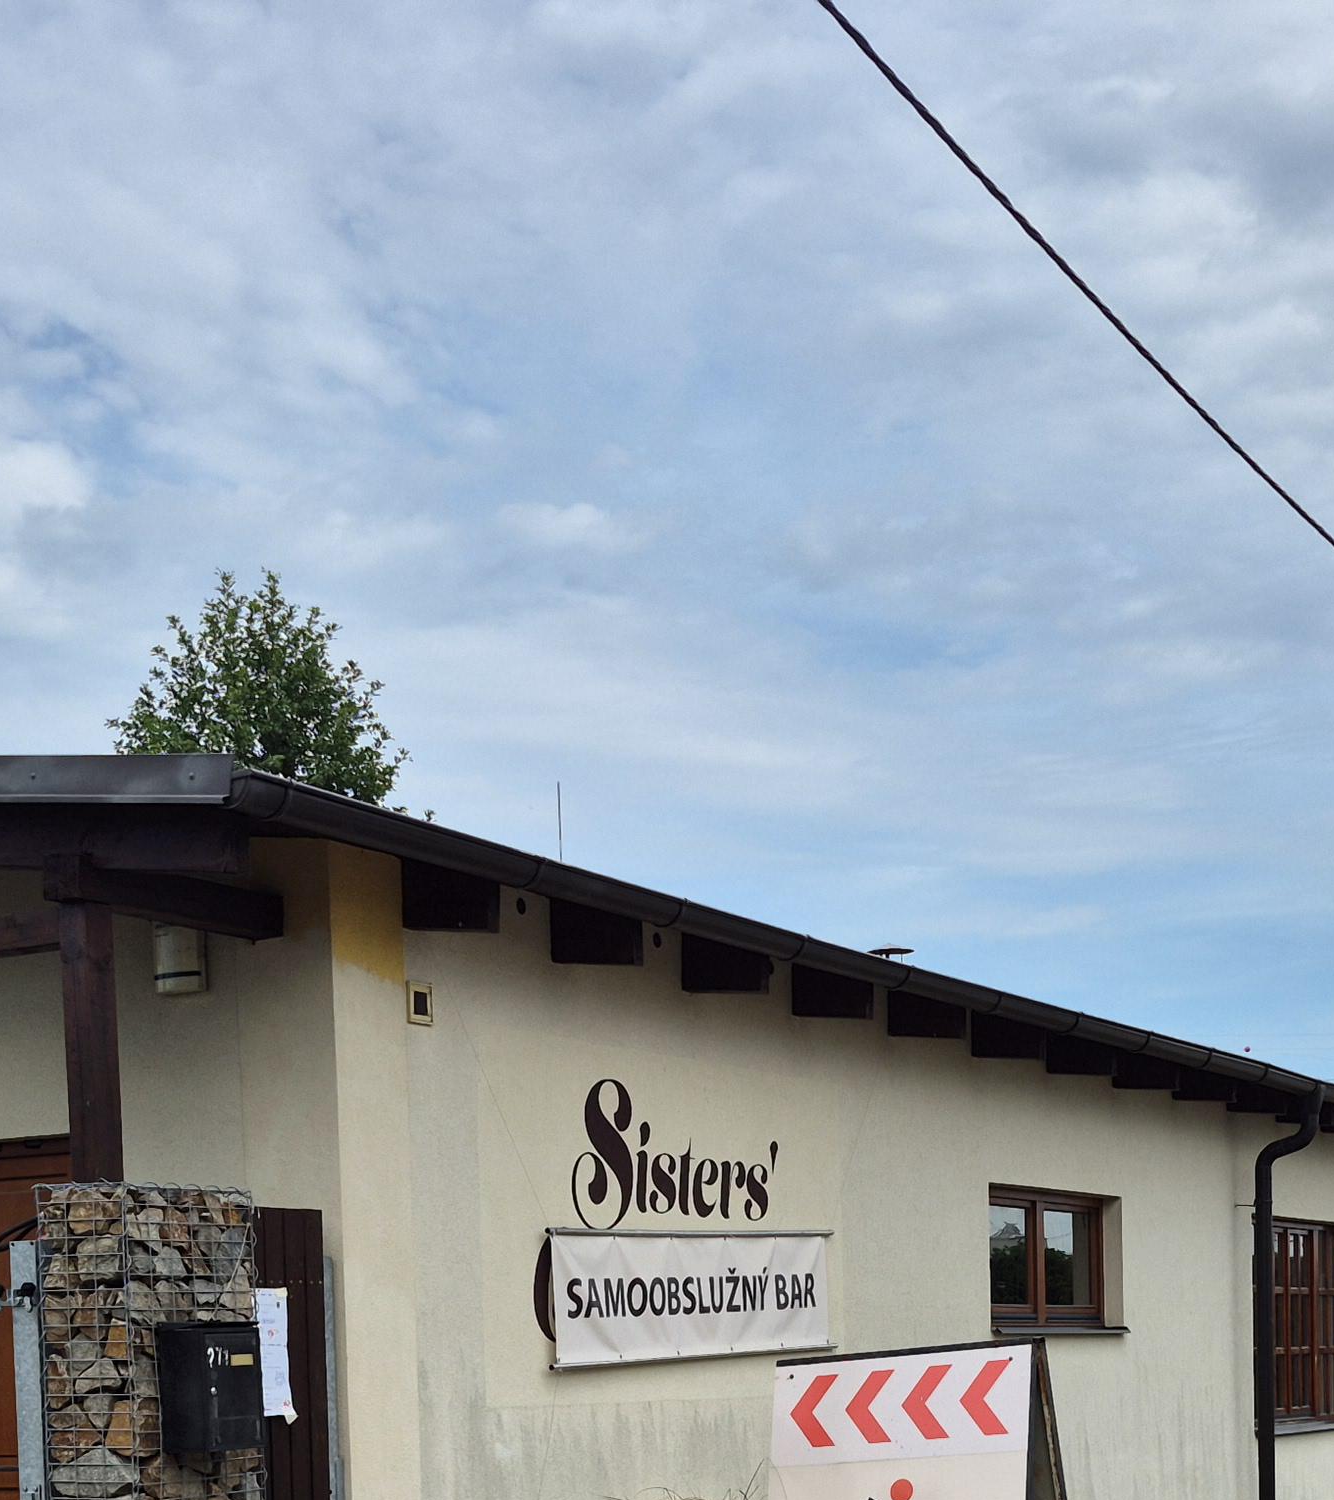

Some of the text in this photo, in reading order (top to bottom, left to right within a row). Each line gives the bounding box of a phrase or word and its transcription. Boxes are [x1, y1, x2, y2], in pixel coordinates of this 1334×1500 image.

[571, 1078, 779, 1230] Sisters'
[567, 1267, 816, 1319] SAMOOBSLUŽNÝ BAR
